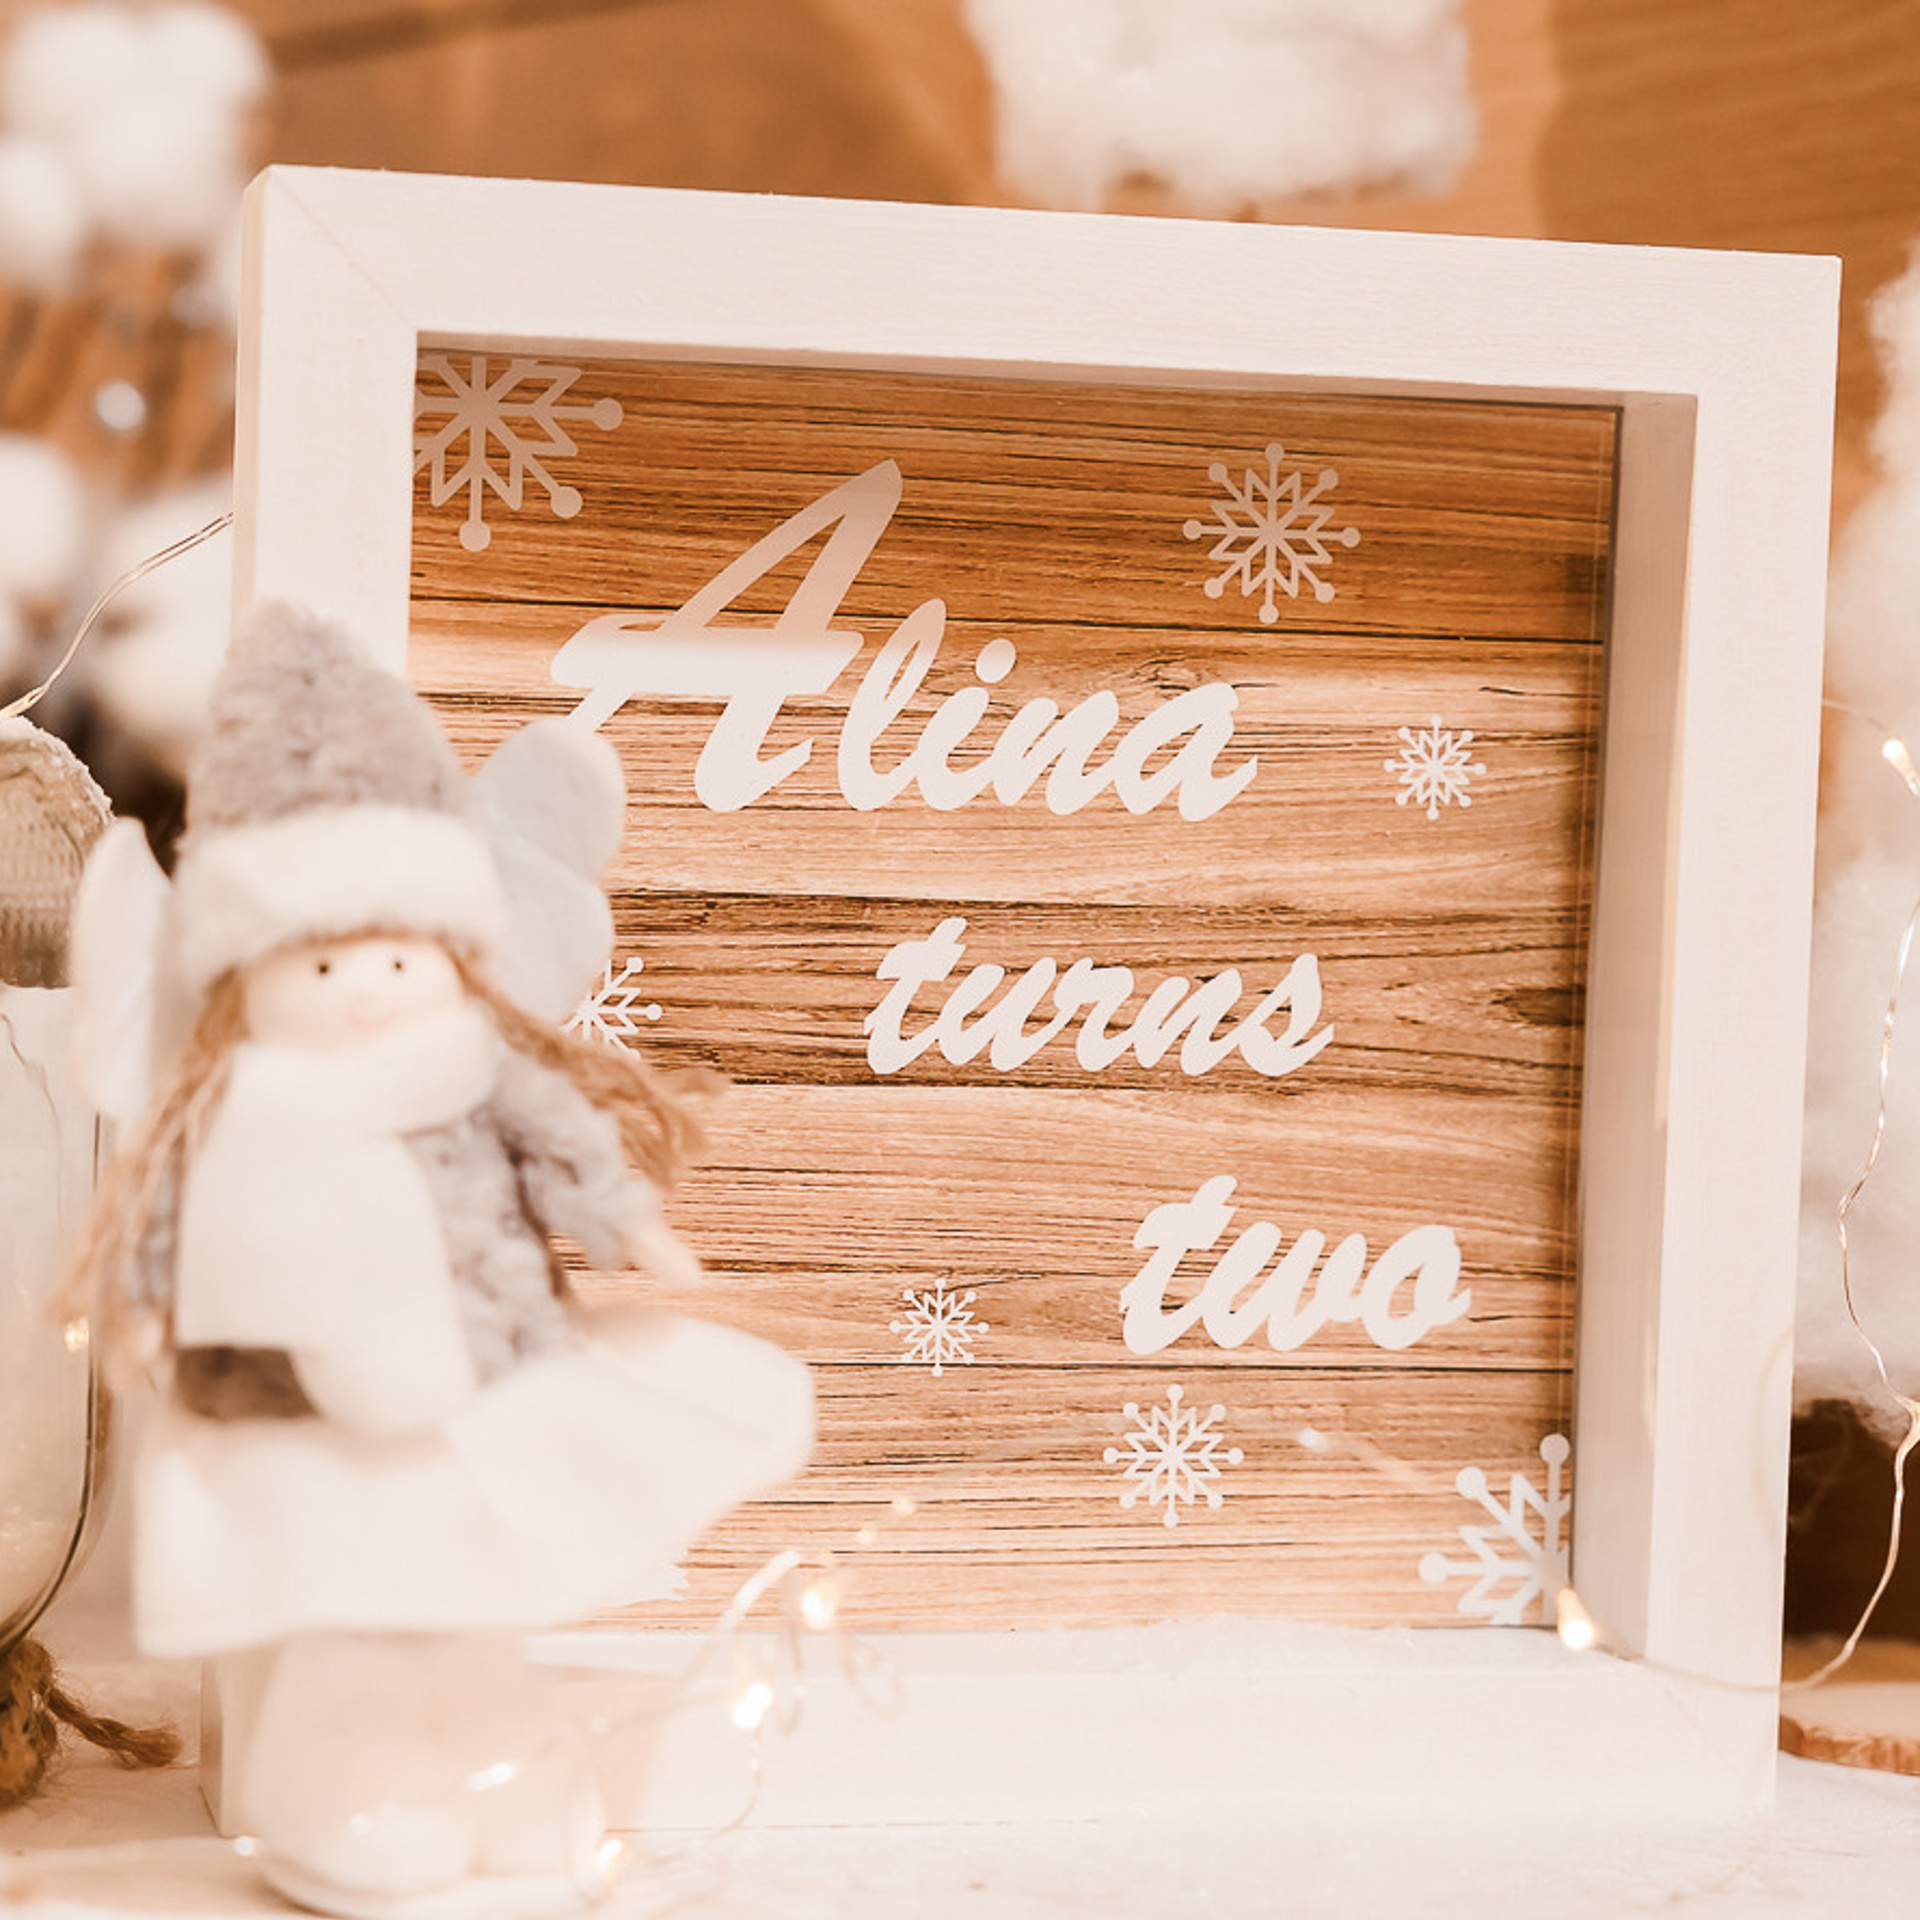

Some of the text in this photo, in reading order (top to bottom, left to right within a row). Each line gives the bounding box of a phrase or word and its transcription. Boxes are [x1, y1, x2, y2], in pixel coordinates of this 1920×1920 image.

[550, 459, 1258, 821] Alina
[863, 917, 1335, 1076] turns
[1119, 1174, 1472, 1355] two
